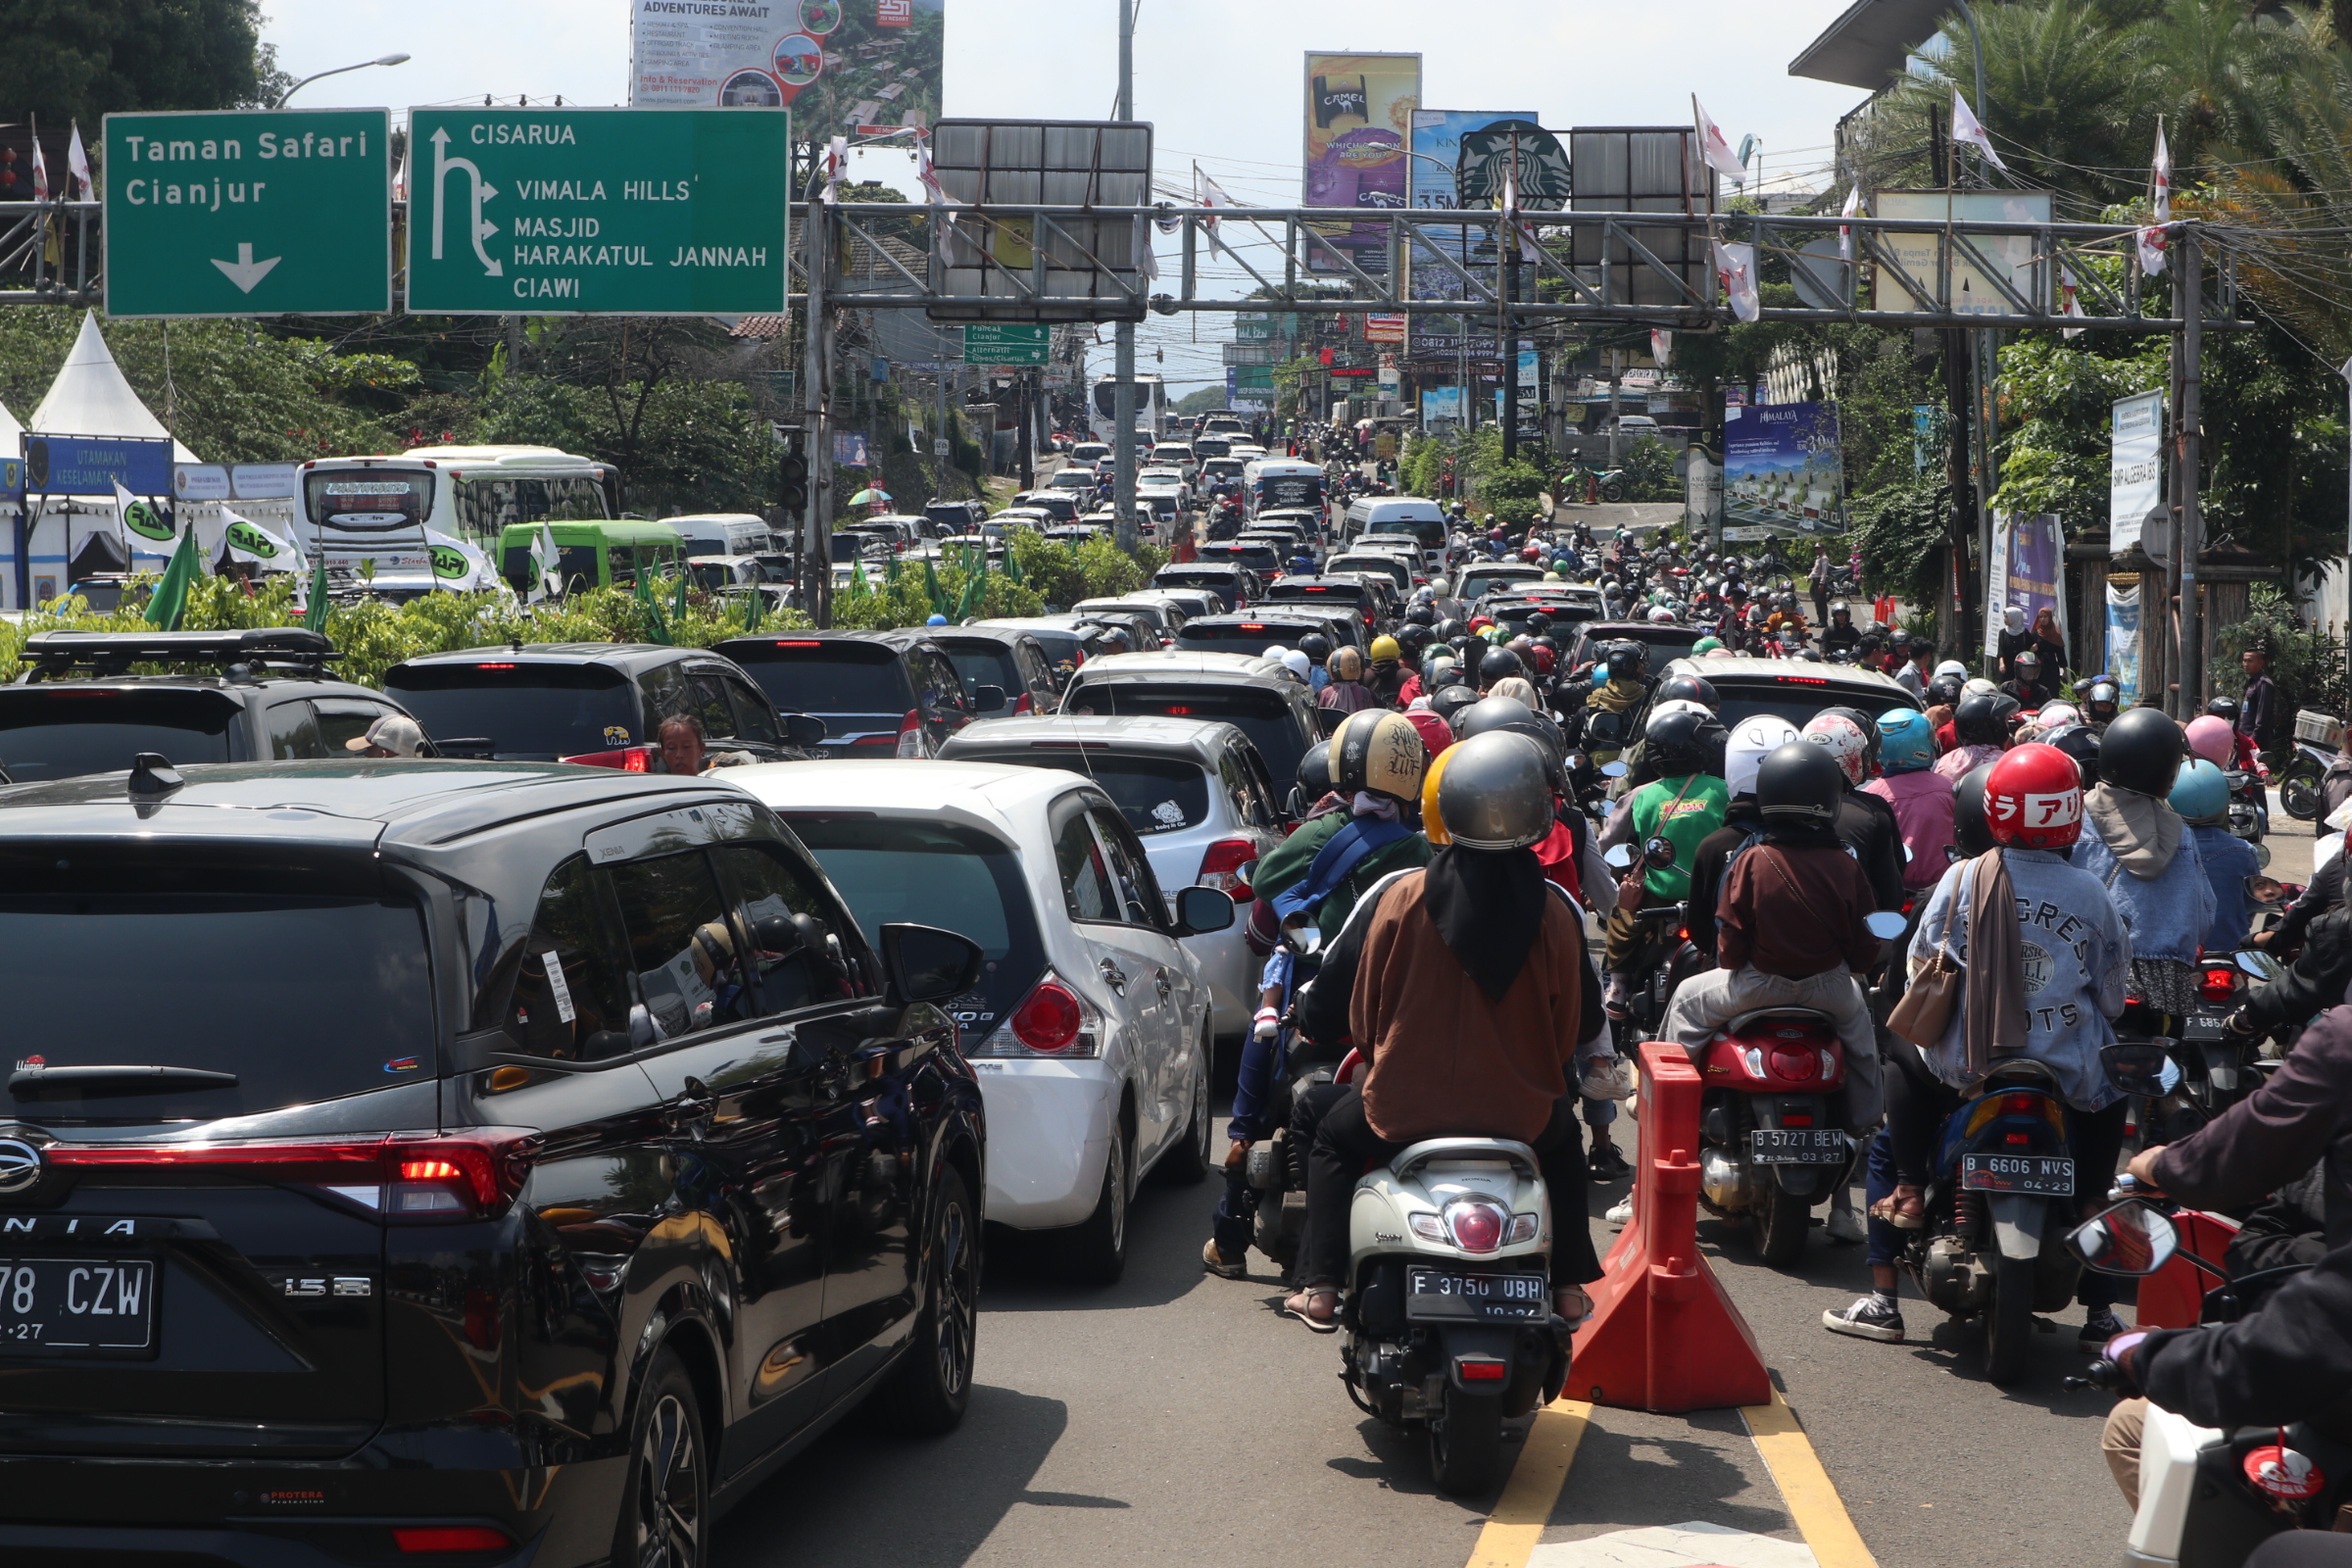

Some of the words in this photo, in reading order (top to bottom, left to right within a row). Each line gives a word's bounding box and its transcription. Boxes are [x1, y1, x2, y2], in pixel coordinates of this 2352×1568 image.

[643, 3, 726, 16] ADVENTURES
[729, 6, 770, 18] AWAIT
[667, 76, 717, 85] Reservation
[1324, 93, 1365, 106] CAMEL
[470, 124, 576, 145] CISARUA
[126, 136, 241, 162] Taman
[259, 131, 368, 159] Safari
[126, 180, 267, 213] Cianjur
[516, 180, 607, 201] VIMALA
[624, 180, 690, 201] HILLS
[514, 218, 599, 238] MASJID
[514, 246, 653, 267] HARAKATUL
[670, 247, 767, 267] JANNAH
[514, 278, 579, 299] CIAWI
[1422, 338, 1445, 347] 0812
[1760, 410, 1797, 423] HIMALAYA
[77, 451, 126, 466] UTAMAKAN
[2114, 468, 2124, 487] SMP
[2125, 465, 2146, 486] ALGEBRA
[2147, 462, 2156, 481] IBS
[329, 482, 408, 494] PARIWISATA
[231, 527, 274, 553] RAPI
[600, 846, 625, 860] XENIA
[2186, 1017, 2193, 1027] F
[1756, 1133, 1764, 1146] B
[1772, 1133, 1807, 1147] 5727
[1815, 1133, 1842, 1147] BEW
[1966, 1156, 1976, 1170] B
[1989, 1158, 2031, 1174] 6606
[2041, 1160, 2072, 1176] NVS
[68, 1267, 143, 1315] CZW
[285, 1278, 327, 1297] 1.5
[1415, 1276, 1426, 1294] F
[1440, 1277, 1490, 1297] 3750
[1503, 1280, 1540, 1298] UBH
